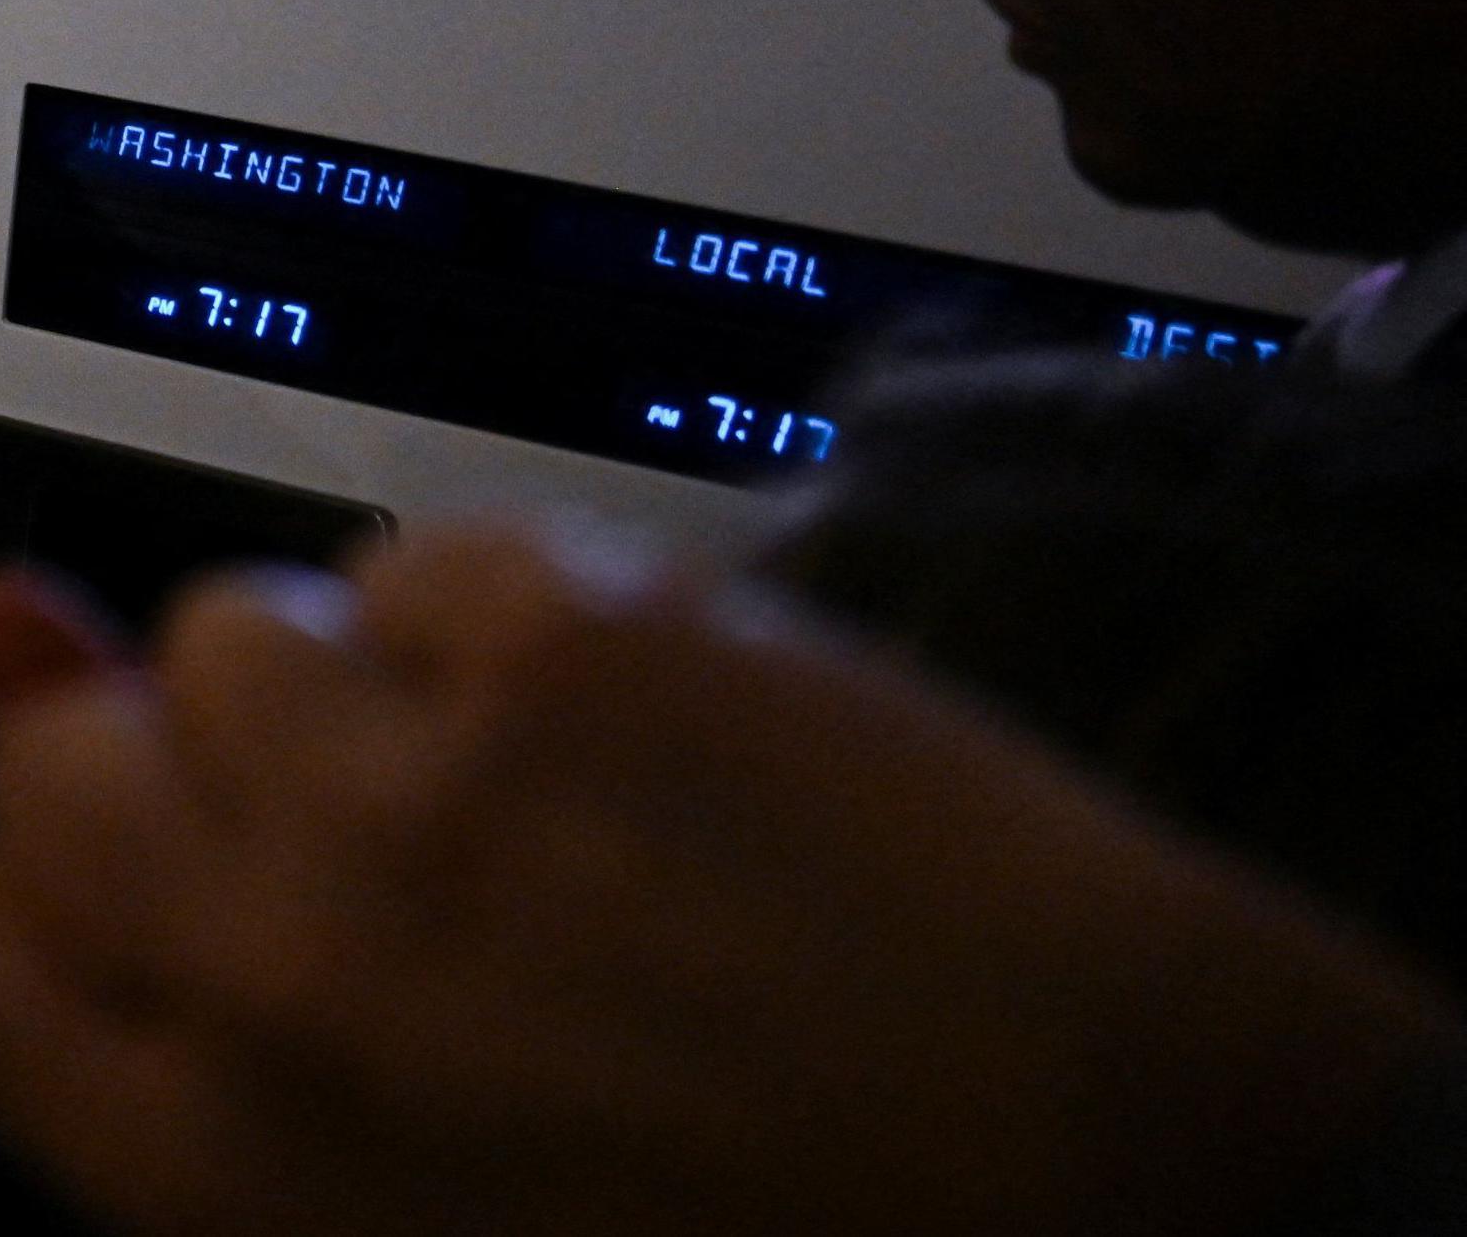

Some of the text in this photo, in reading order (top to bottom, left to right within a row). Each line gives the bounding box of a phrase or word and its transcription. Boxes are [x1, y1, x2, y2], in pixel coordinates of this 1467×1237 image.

[88, 122, 405, 210] WASHINGTON
[652, 227, 826, 297] LOCAL
[147, 285, 308, 345] PM 7:17
[707, 395, 837, 460] 7:17
